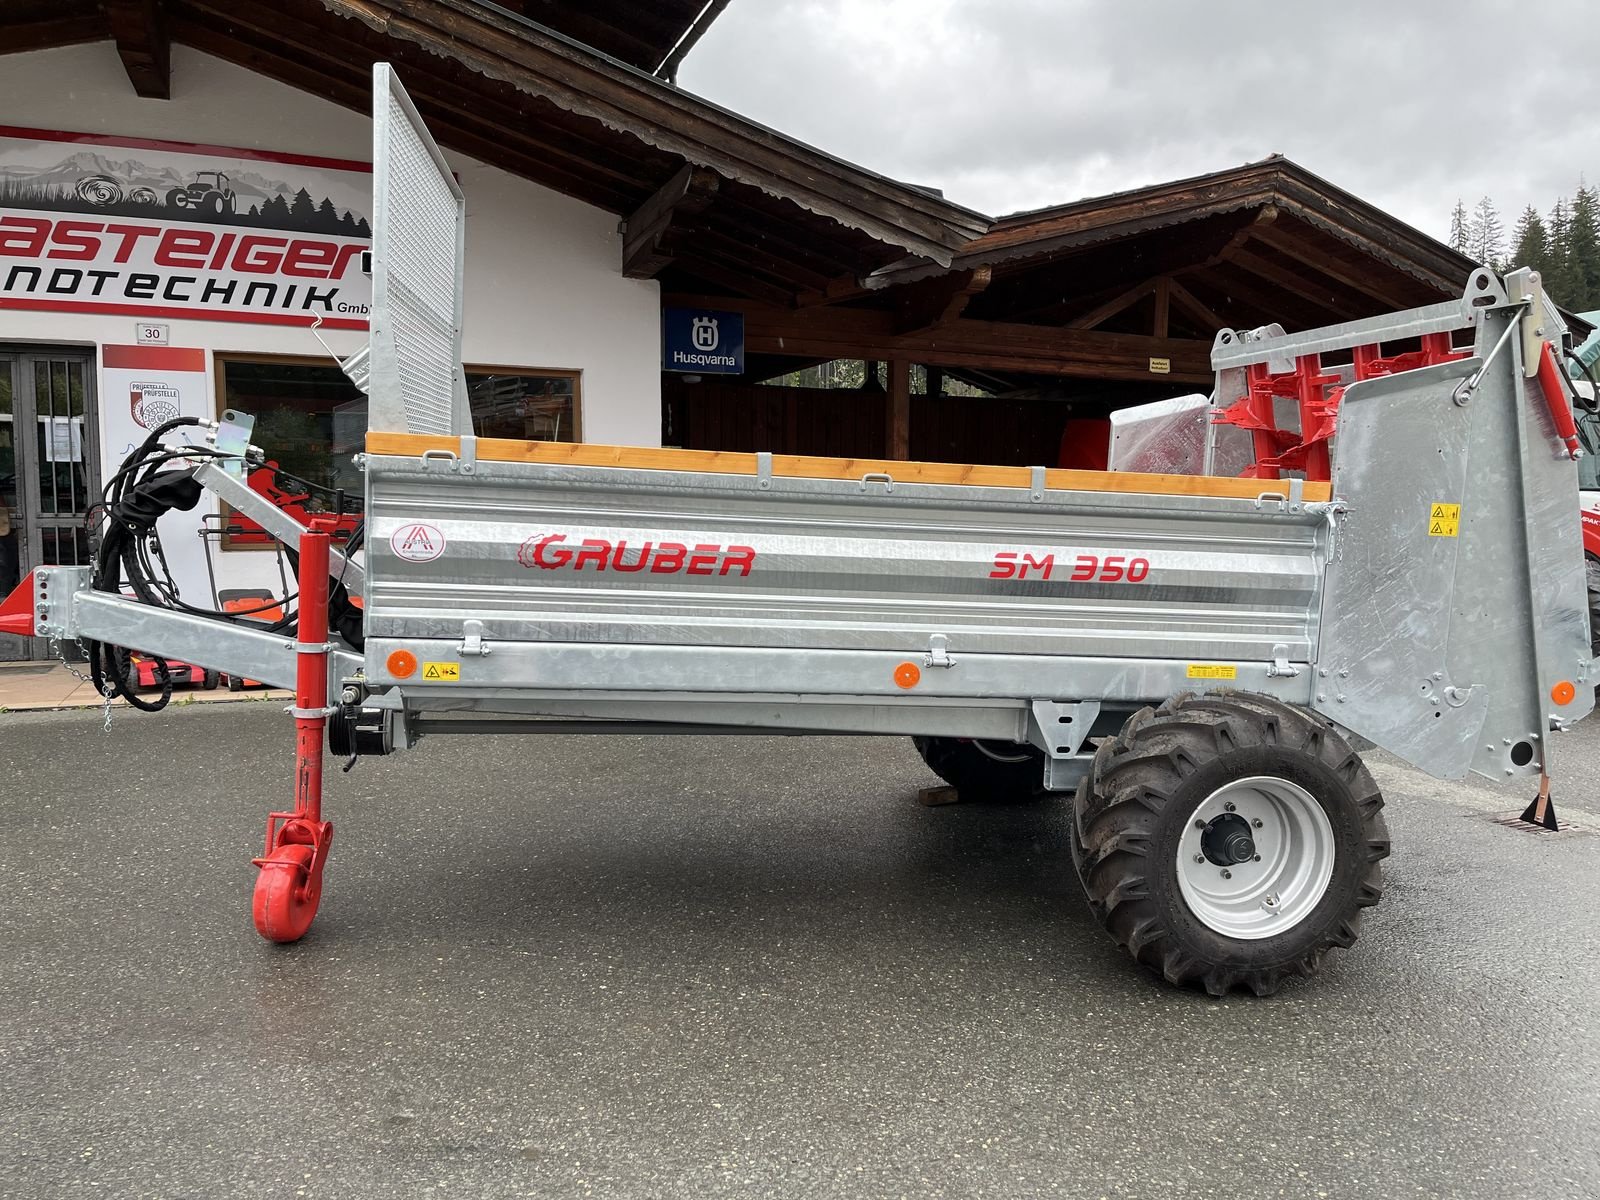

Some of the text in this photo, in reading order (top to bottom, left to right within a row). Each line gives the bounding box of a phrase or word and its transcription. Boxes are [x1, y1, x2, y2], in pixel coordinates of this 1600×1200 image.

[337, 302, 373, 315] Gmb
[145, 328, 160, 339] 30
[674, 351, 735, 366] Husqvarna
[532, 533, 756, 577] GRUBER
[989, 552, 1150, 583] SM 350
